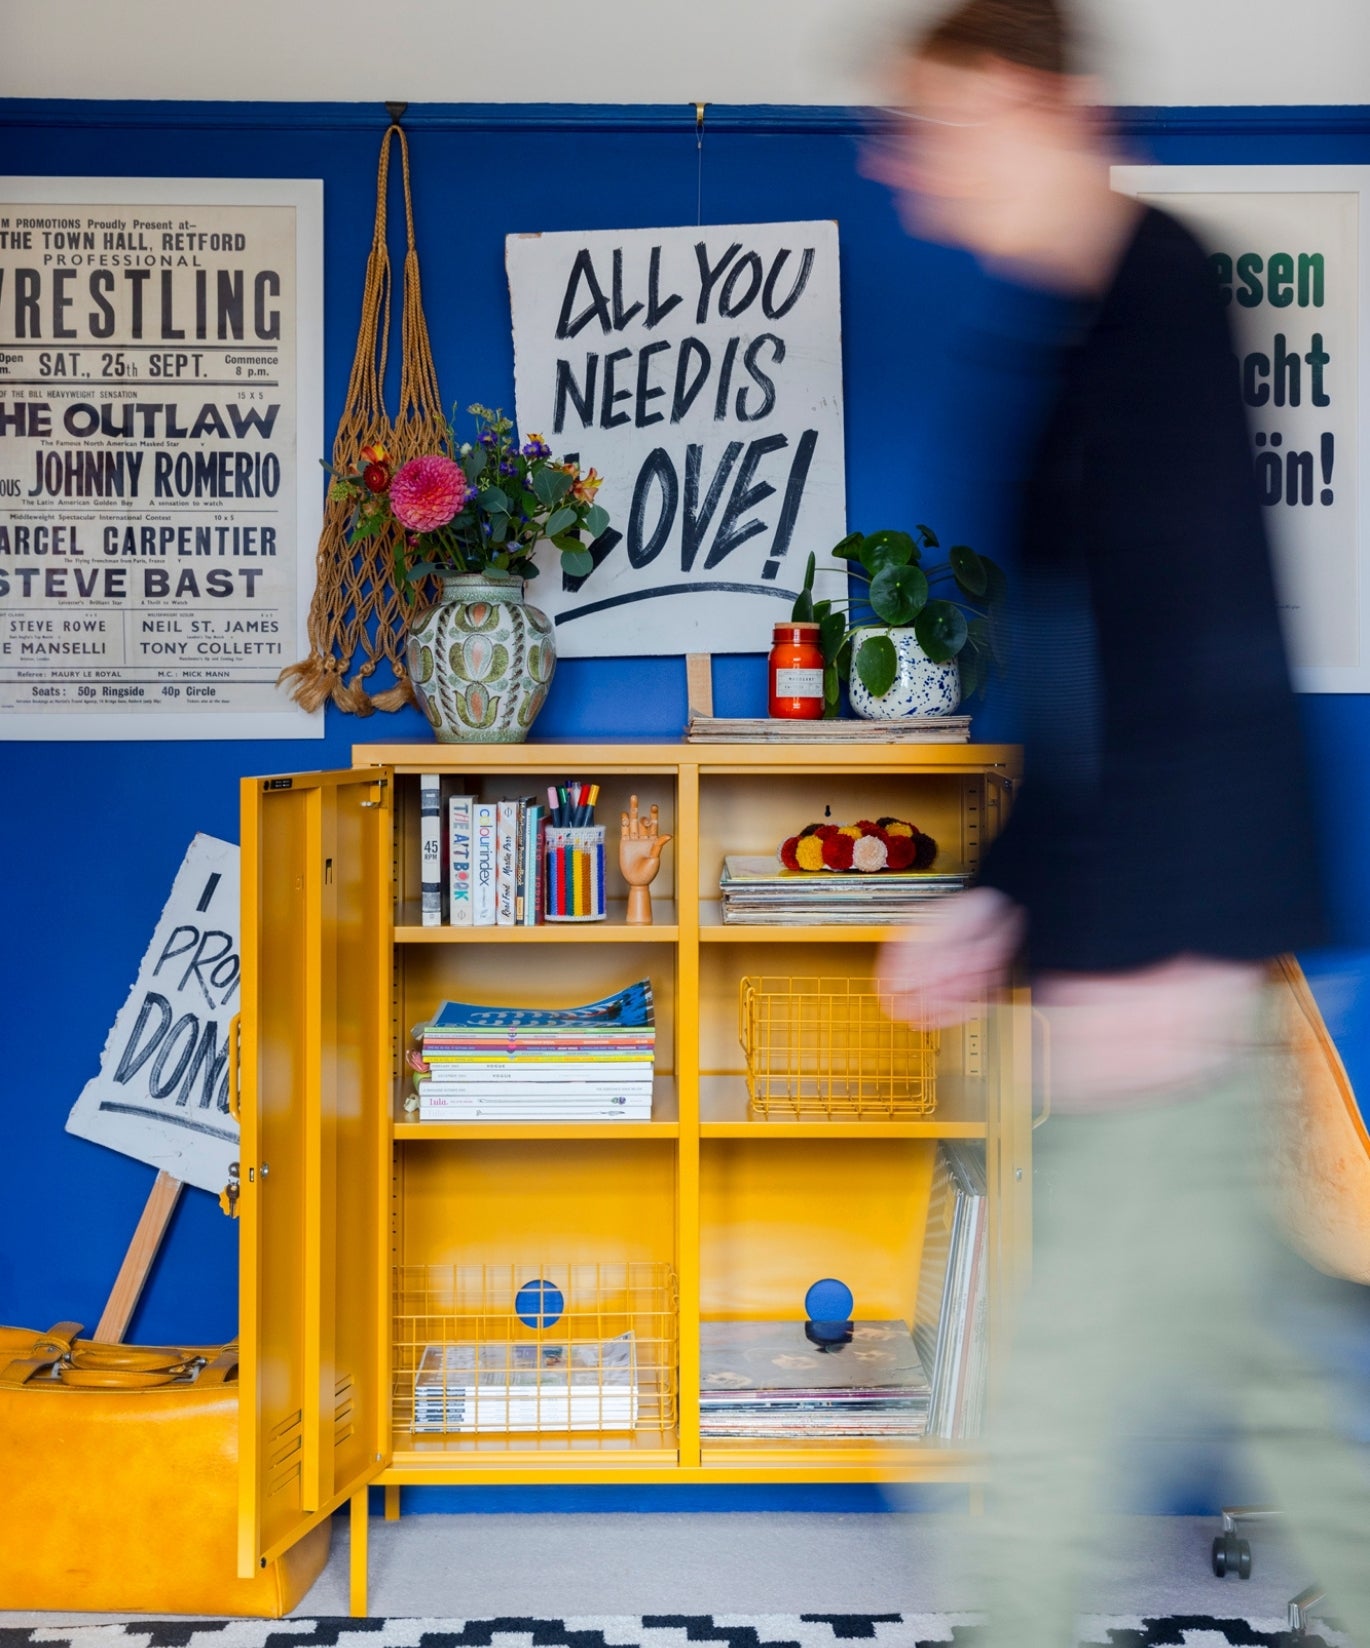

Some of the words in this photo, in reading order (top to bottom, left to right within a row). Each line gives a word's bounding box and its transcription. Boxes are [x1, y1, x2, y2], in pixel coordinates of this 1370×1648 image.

[16, 218, 80, 229] PROMOTIONS
[88, 219, 126, 231] Proudly
[133, 219, 172, 230] Present
[0, 232, 32, 250] THE
[42, 232, 95, 250] TOWN
[103, 232, 153, 252] HALL,
[162, 233, 246, 252] RETFORD
[44, 254, 202, 267] PROFESSIONAL
[555, 245, 684, 341] ALL
[694, 242, 815, 324] YOU
[0, 268, 280, 340] RESTLING
[39, 352, 91, 378] SAT.,
[101, 353, 138, 377] 25th
[149, 354, 208, 378] SEPT.
[224, 354, 279, 365] Commence
[236, 366, 242, 376] 8
[248, 367, 270, 378] p.m.
[1233, 333, 1330, 407] cht
[552, 336, 712, 434] NEED
[714, 332, 786, 422] IS
[12, 390, 25, 398] THE
[28, 390, 43, 398] BILL
[46, 390, 95, 399] HEAVYWEIGHT
[100, 390, 138, 399] SENSATION
[237, 392, 246, 400] 15
[64, 403, 281, 440] OUTLAW
[28, 450, 144, 498] JOHNNY
[154, 451, 280, 498] ROMERIO
[103, 526, 277, 556] CARPENTIER
[144, 568, 264, 598] BAST
[10, 620, 53, 632] STEVE
[63, 620, 106, 632] ROWE
[142, 620, 182, 632] NEIL
[191, 620, 215, 632] ST.
[224, 620, 279, 632] JAMES
[21, 642, 106, 654] MANSELLI
[140, 642, 188, 654] TONY
[196, 642, 282, 654] COLLETTI
[78, 686, 97, 698] 50p
[102, 686, 144, 698] Ringside
[161, 686, 180, 698] 40p
[186, 686, 216, 696] Circle
[454, 803, 468, 830] THE
[424, 840, 438, 854] 45
[454, 862, 469, 901] BOOK
[196, 872, 222, 913] I
